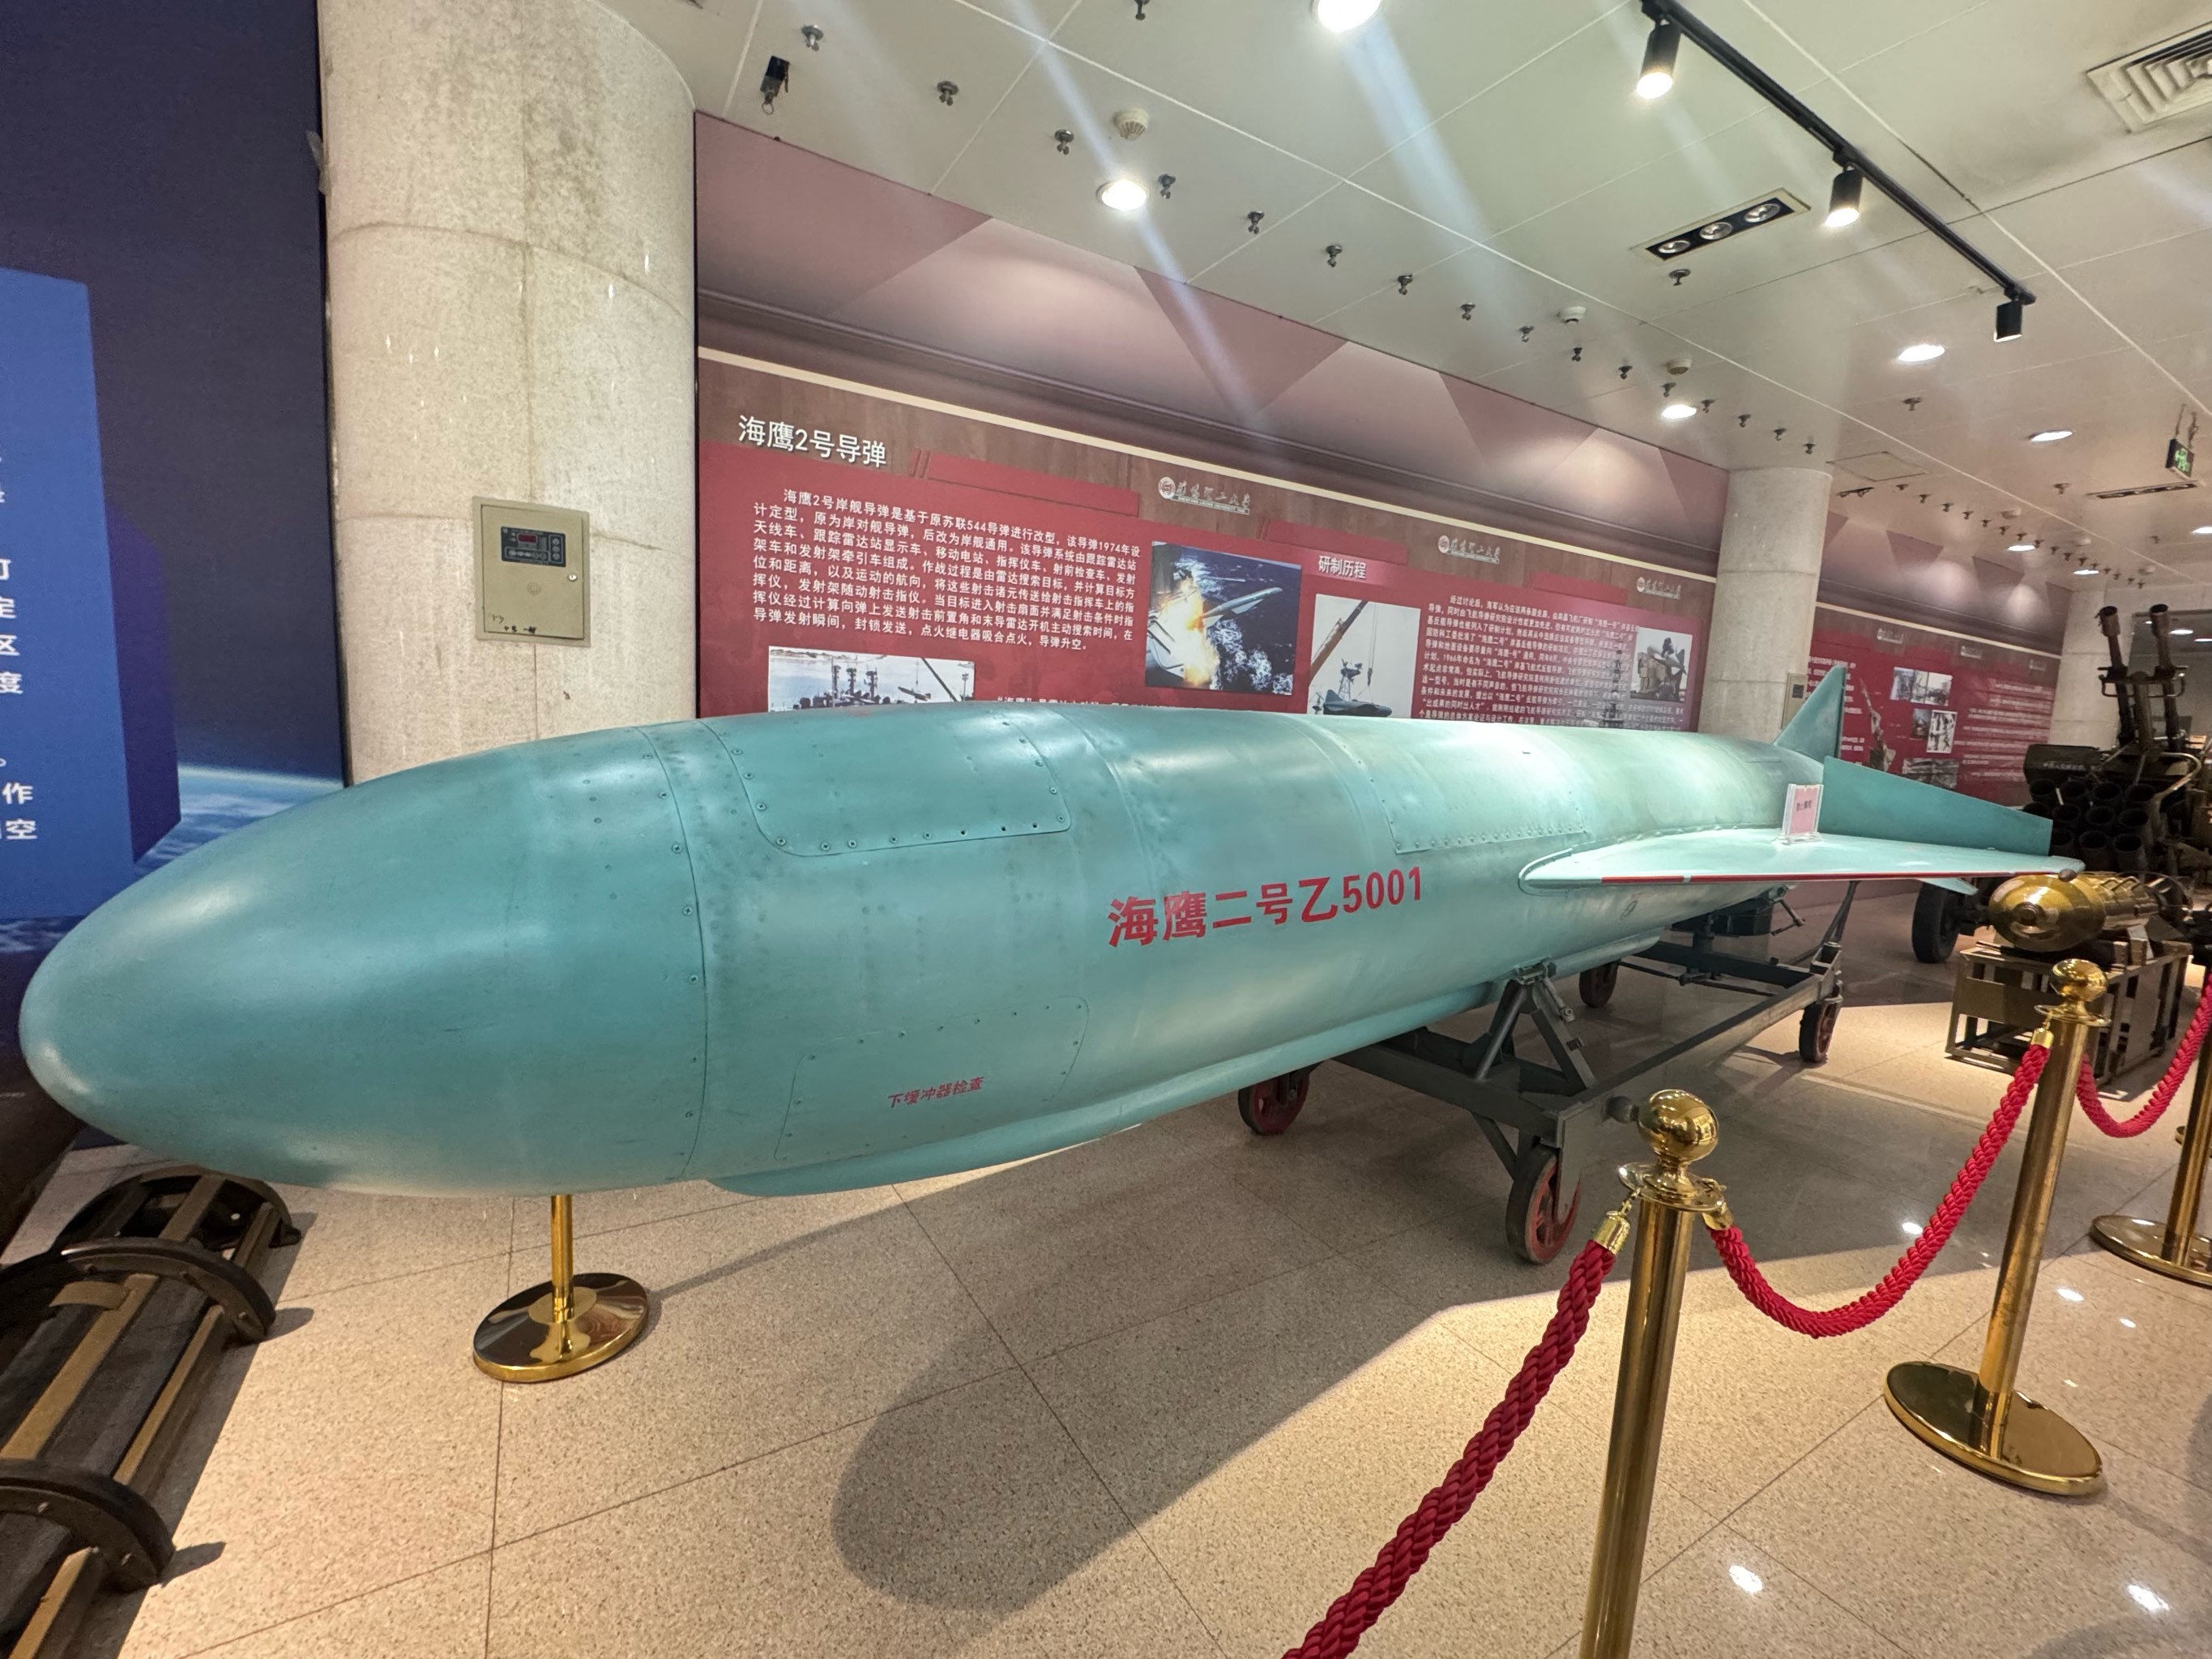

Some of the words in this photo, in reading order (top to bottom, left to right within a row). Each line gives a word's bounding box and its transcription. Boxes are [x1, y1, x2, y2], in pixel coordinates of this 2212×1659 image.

[738, 415, 886, 468] 海鹰2号导弹
[1318, 555, 1367, 579] 研制历程
[2, 782, 34, 804] 作
[0, 818, 37, 840] 空
[1108, 866, 1421, 947] 海鹰二号乙5001
